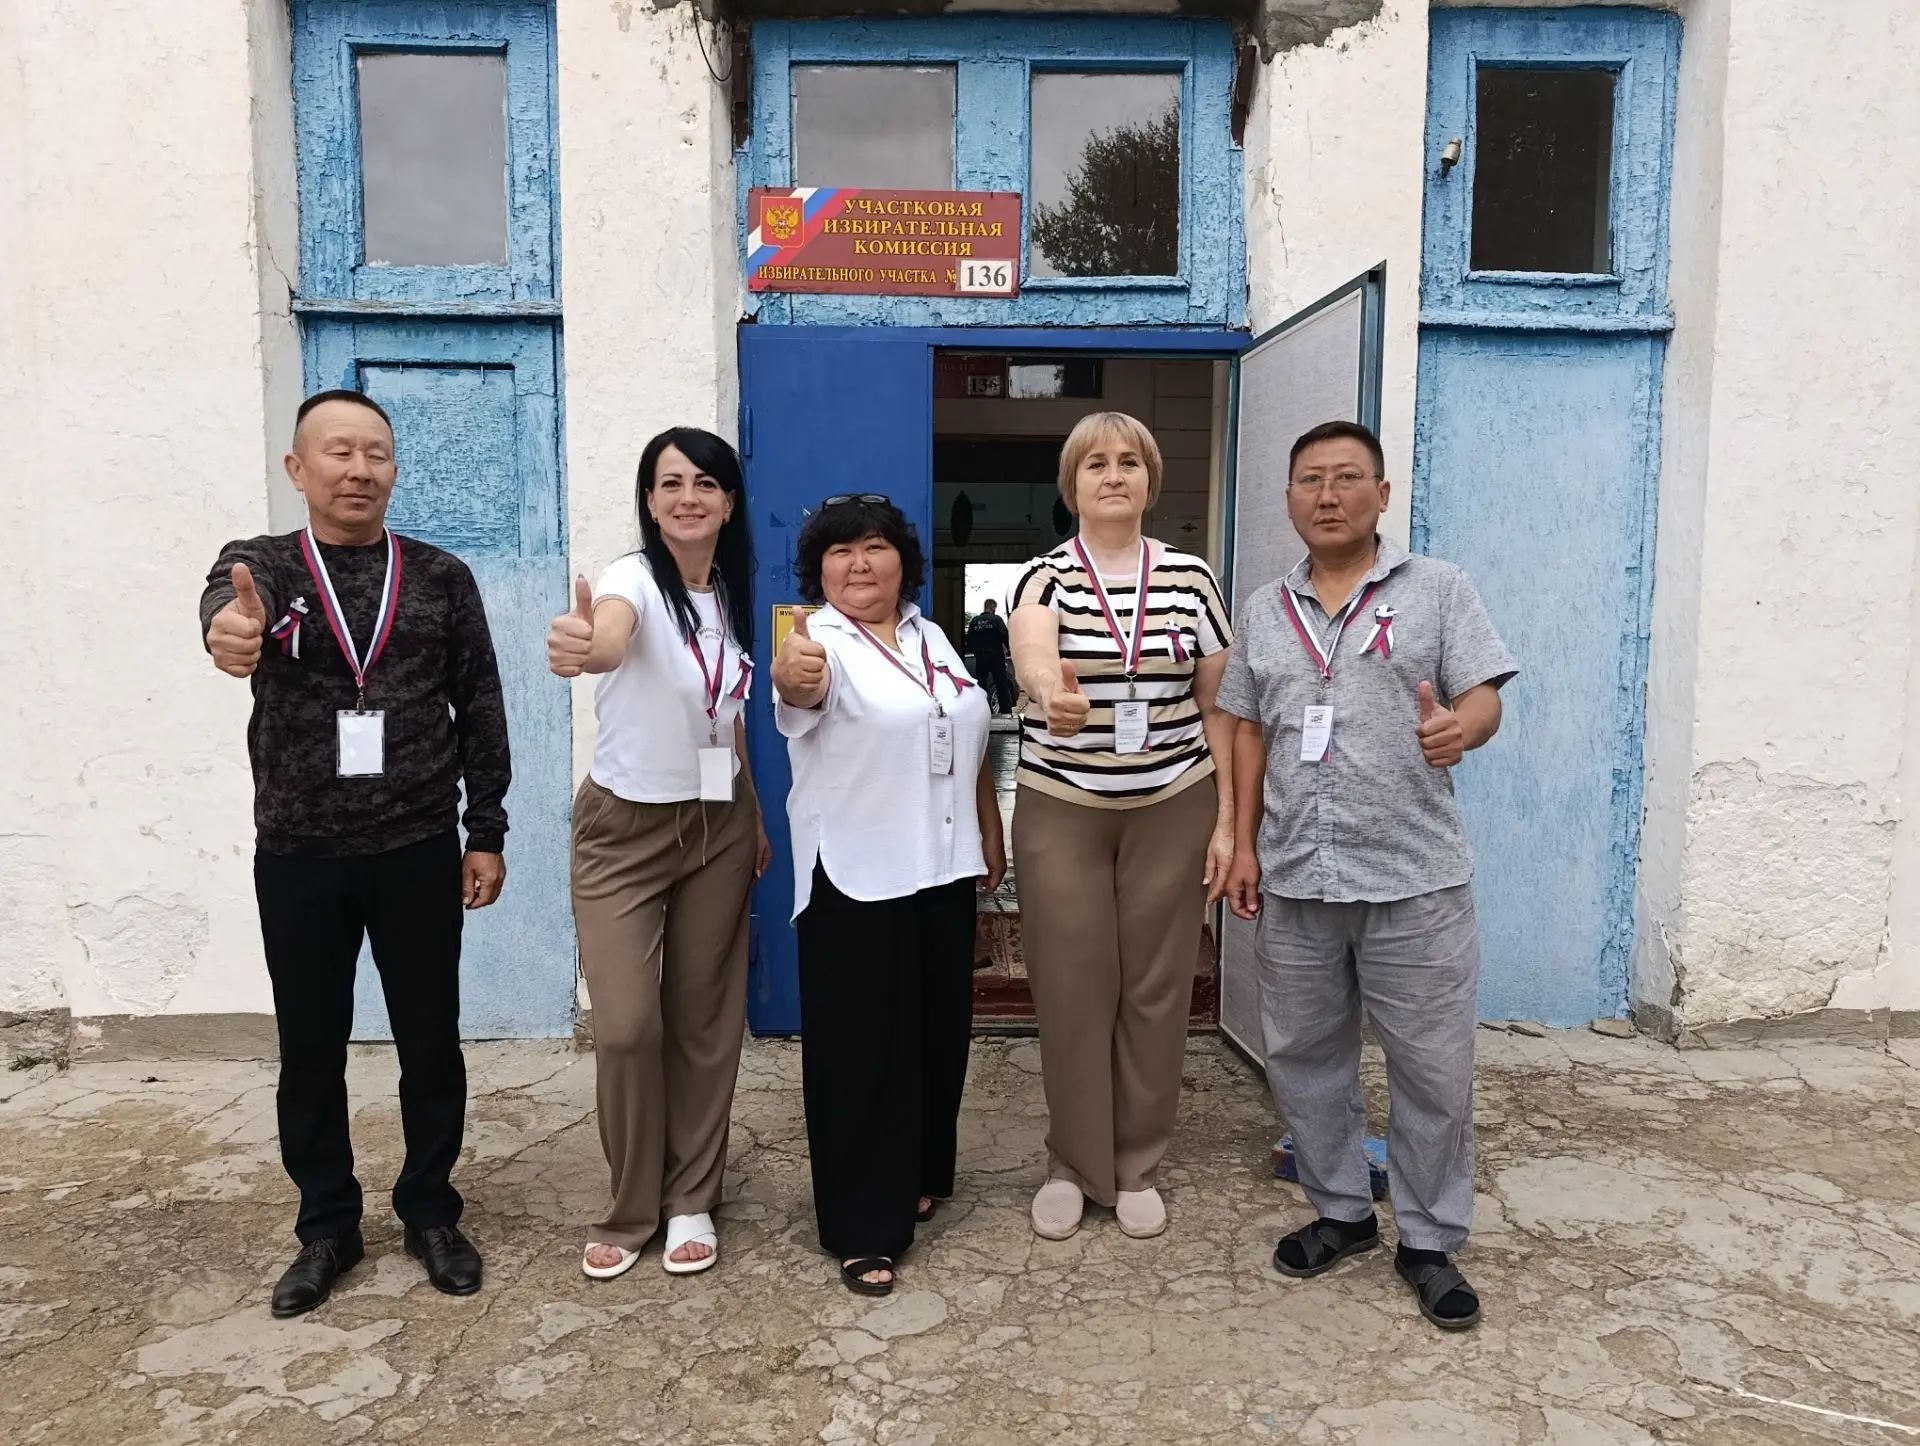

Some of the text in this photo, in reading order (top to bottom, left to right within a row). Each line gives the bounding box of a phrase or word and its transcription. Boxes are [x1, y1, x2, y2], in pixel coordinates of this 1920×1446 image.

[845, 199, 984, 217] УЧАСТКОВАЯ
[823, 218, 1003, 237] ИЗБИРАТЕЛЬНАЯ
[854, 239, 973, 257] КОМИССИЯ
[758, 265, 1007, 287] ИЗБИРАТЕЛЬНОГО УЧАСТКА № 136
